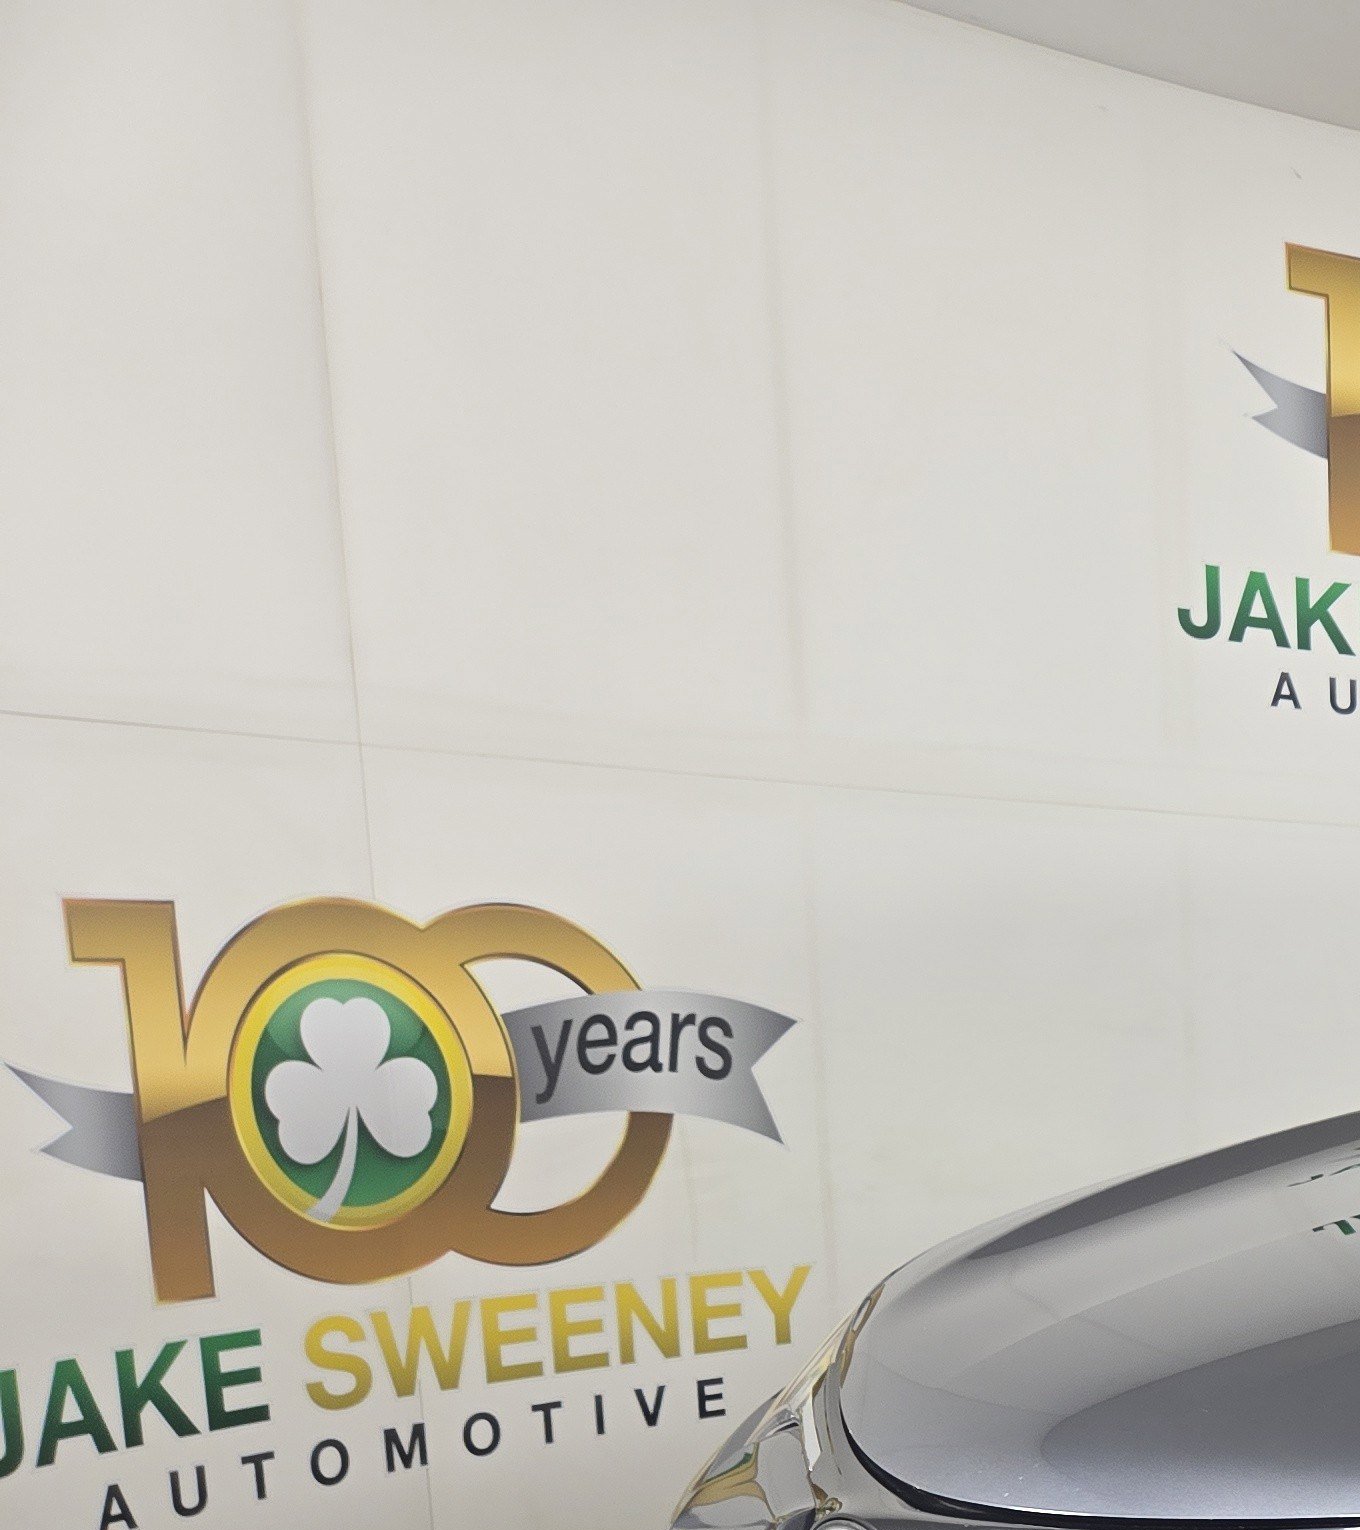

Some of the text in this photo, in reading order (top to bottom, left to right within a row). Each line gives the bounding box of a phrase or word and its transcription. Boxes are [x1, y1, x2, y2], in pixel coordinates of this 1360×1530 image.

[61, 896, 735, 1304] 100 years
[304, 1265, 812, 1411] SWEENEY
